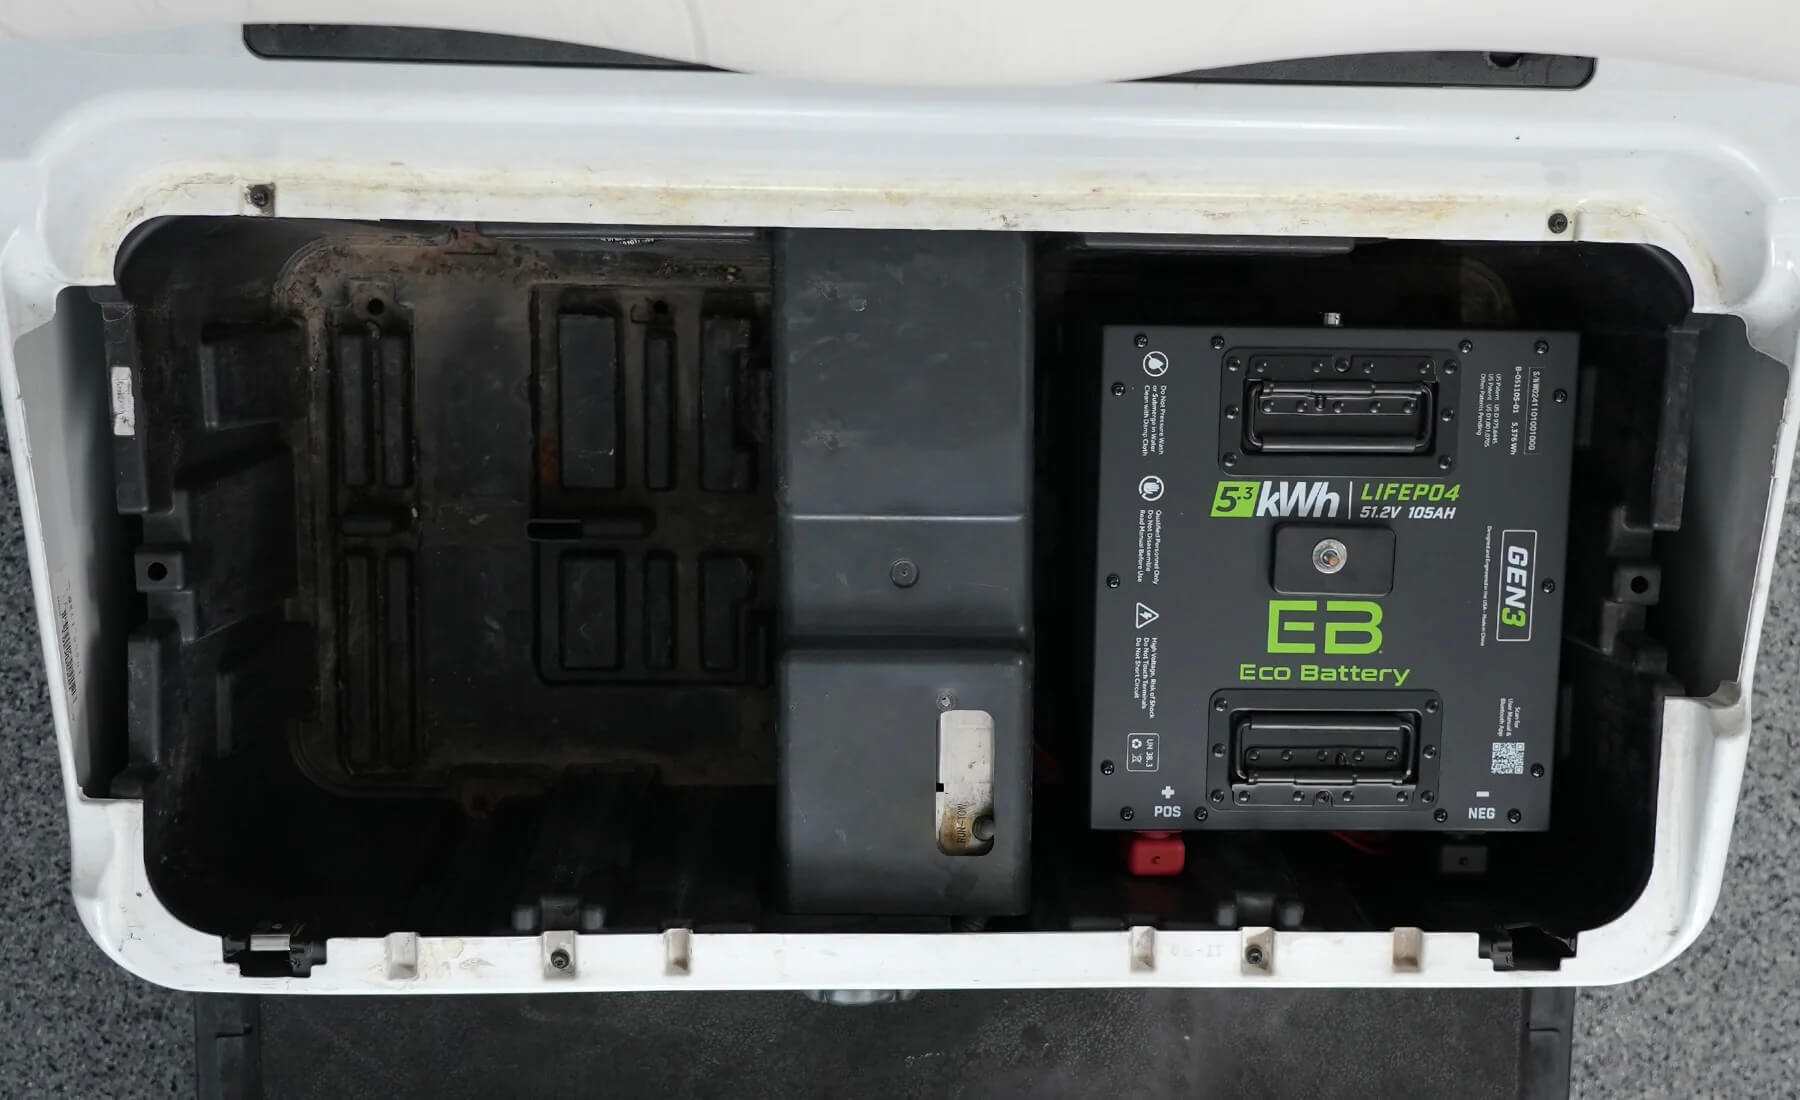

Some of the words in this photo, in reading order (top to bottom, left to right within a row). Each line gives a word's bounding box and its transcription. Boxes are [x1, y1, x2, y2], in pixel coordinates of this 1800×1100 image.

[1161, 385, 1167, 395] Do
[1150, 393, 1158, 425] Submerge
[1486, 404, 1492, 412] US
[1494, 404, 1500, 412] US
[1476, 412, 1484, 435] Pending
[1510, 443, 1517, 455] Wh
[1360, 483, 1461, 501] LIFEPO4
[1256, 481, 1340, 517] kWh
[1147, 510, 1154, 519] Do
[1360, 505, 1401, 519] 51.2V
[1408, 507, 1456, 520] 105AH
[1152, 570, 1160, 584] Only
[1501, 545, 1528, 627] GEN3
[1267, 600, 1383, 654] EB
[1136, 638, 1142, 647] Do
[1144, 638, 1150, 647] Do
[1150, 638, 1158, 652] High
[1239, 663, 1291, 680] Eco
[1300, 664, 1410, 686] Battery
[1497, 725, 1505, 736] App
[1145, 739, 1154, 750] UN
[1146, 752, 1154, 768] 38.3
[1154, 805, 1181, 817] POS
[1468, 807, 1496, 819] NEG
